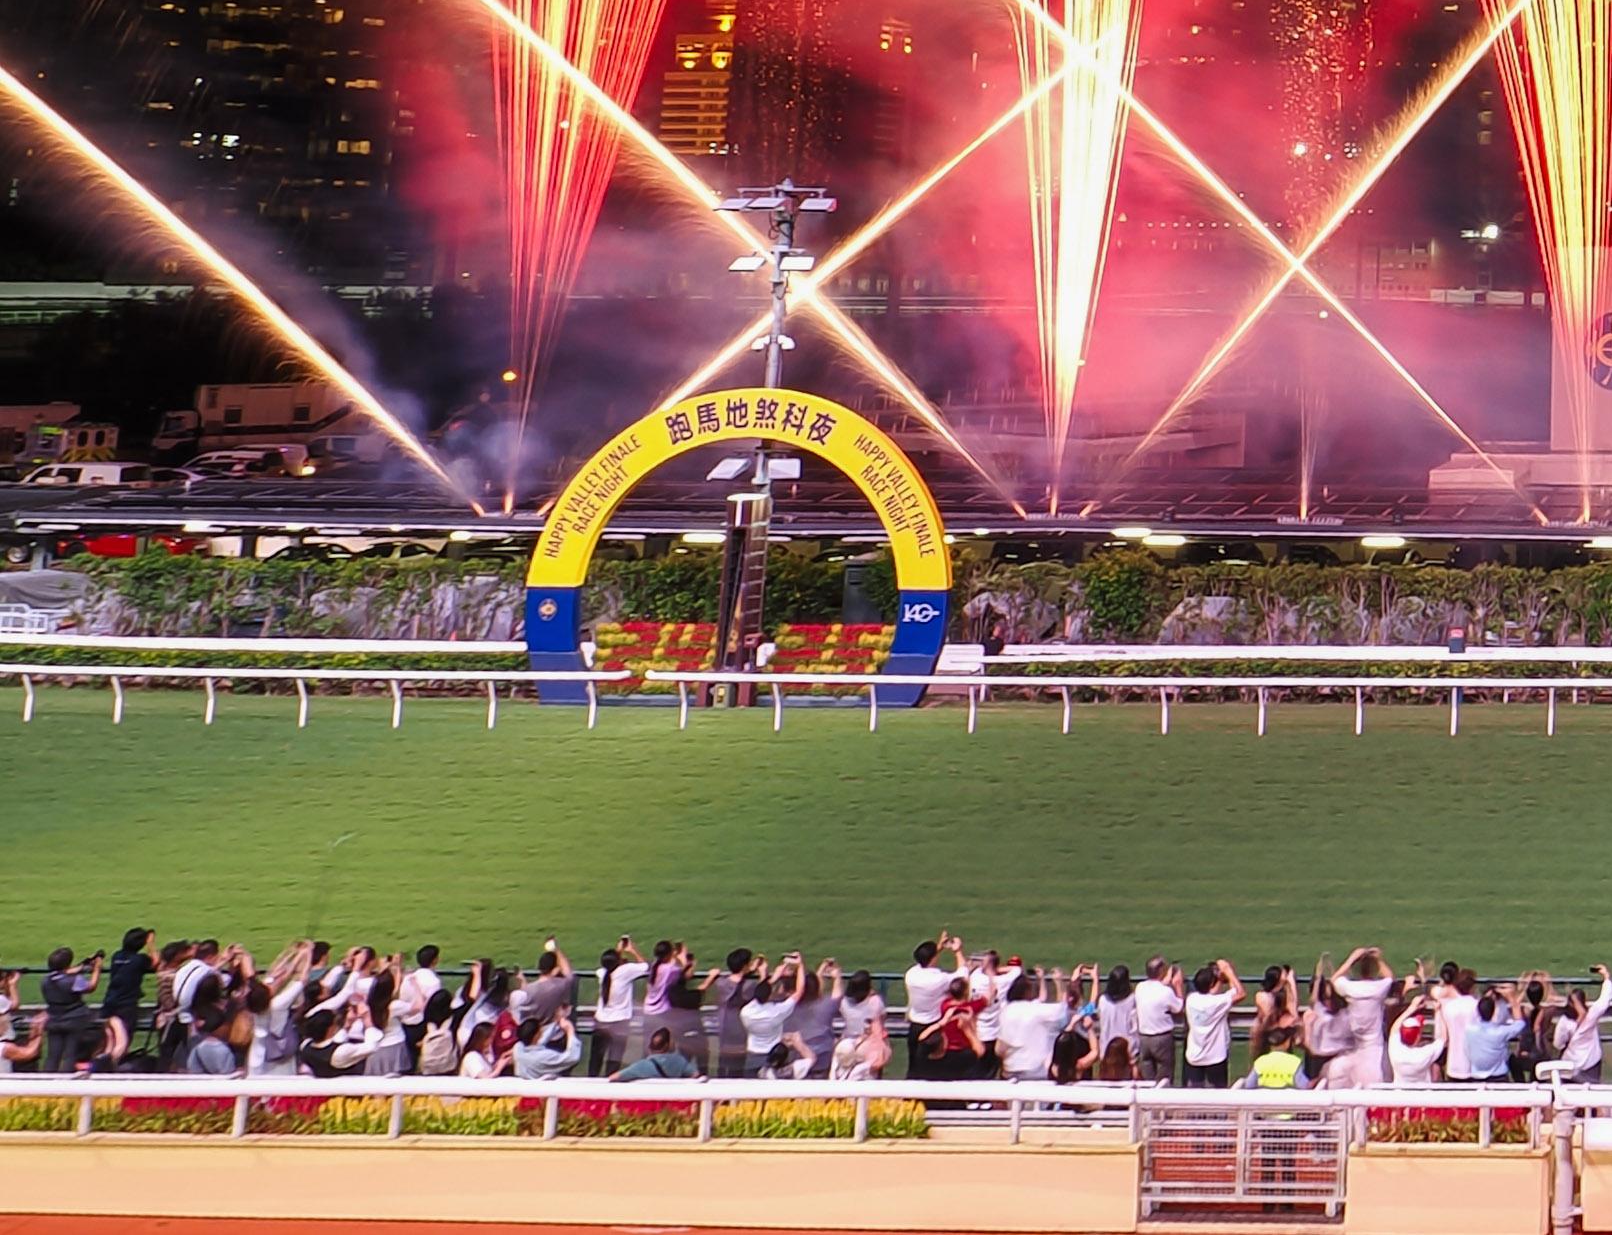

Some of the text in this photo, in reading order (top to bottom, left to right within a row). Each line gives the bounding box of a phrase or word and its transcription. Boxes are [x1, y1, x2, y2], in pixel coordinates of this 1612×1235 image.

[665, 398, 837, 445] 跑馬地煞科夜
[544, 434, 642, 558] HAPPY VALLEY FINALE
[572, 465, 629, 534] RACE NIGHT
[853, 434, 935, 558] HAPPY VALLEY FINALE
[861, 464, 911, 532] RACE NIGHT
